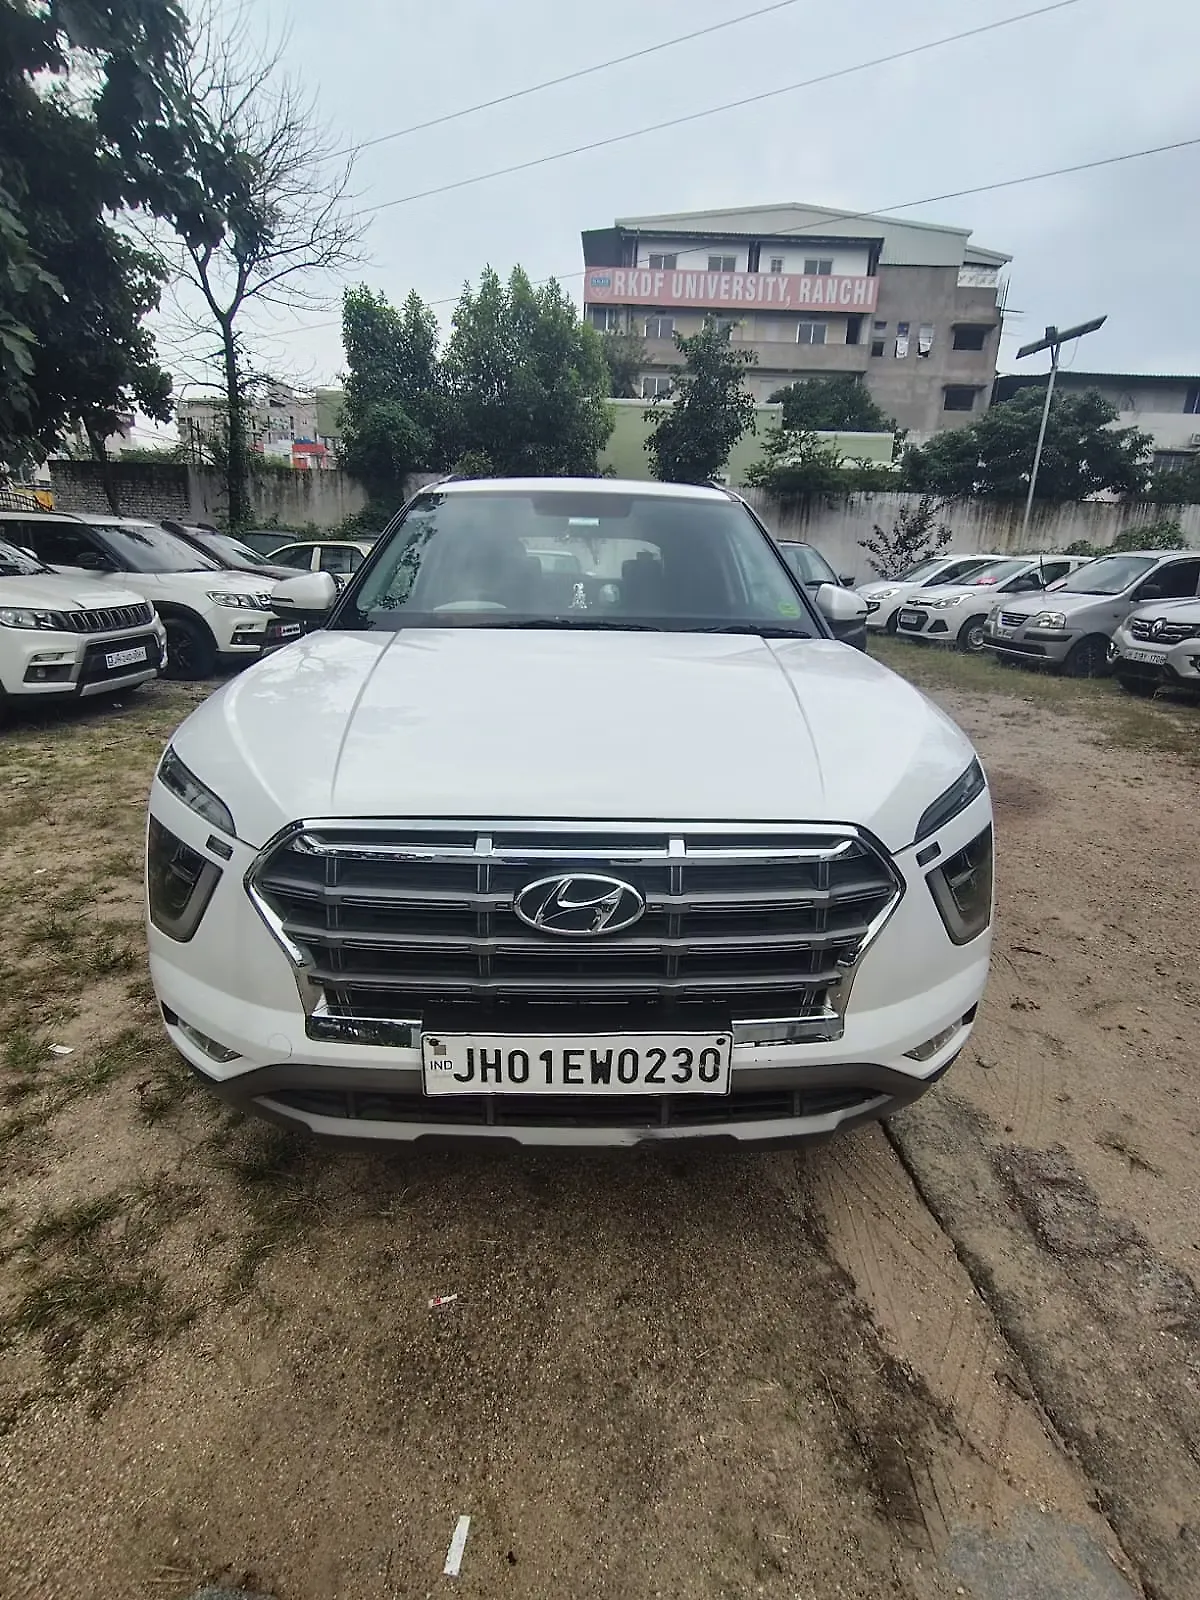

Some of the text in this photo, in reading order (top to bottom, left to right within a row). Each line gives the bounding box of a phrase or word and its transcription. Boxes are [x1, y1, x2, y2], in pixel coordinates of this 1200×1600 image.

[614, 270, 875, 308] RKDF UNIVERSITY, RANCHI
[429, 1060, 453, 1071] IND
[453, 1047, 722, 1085] JH01EW0230
